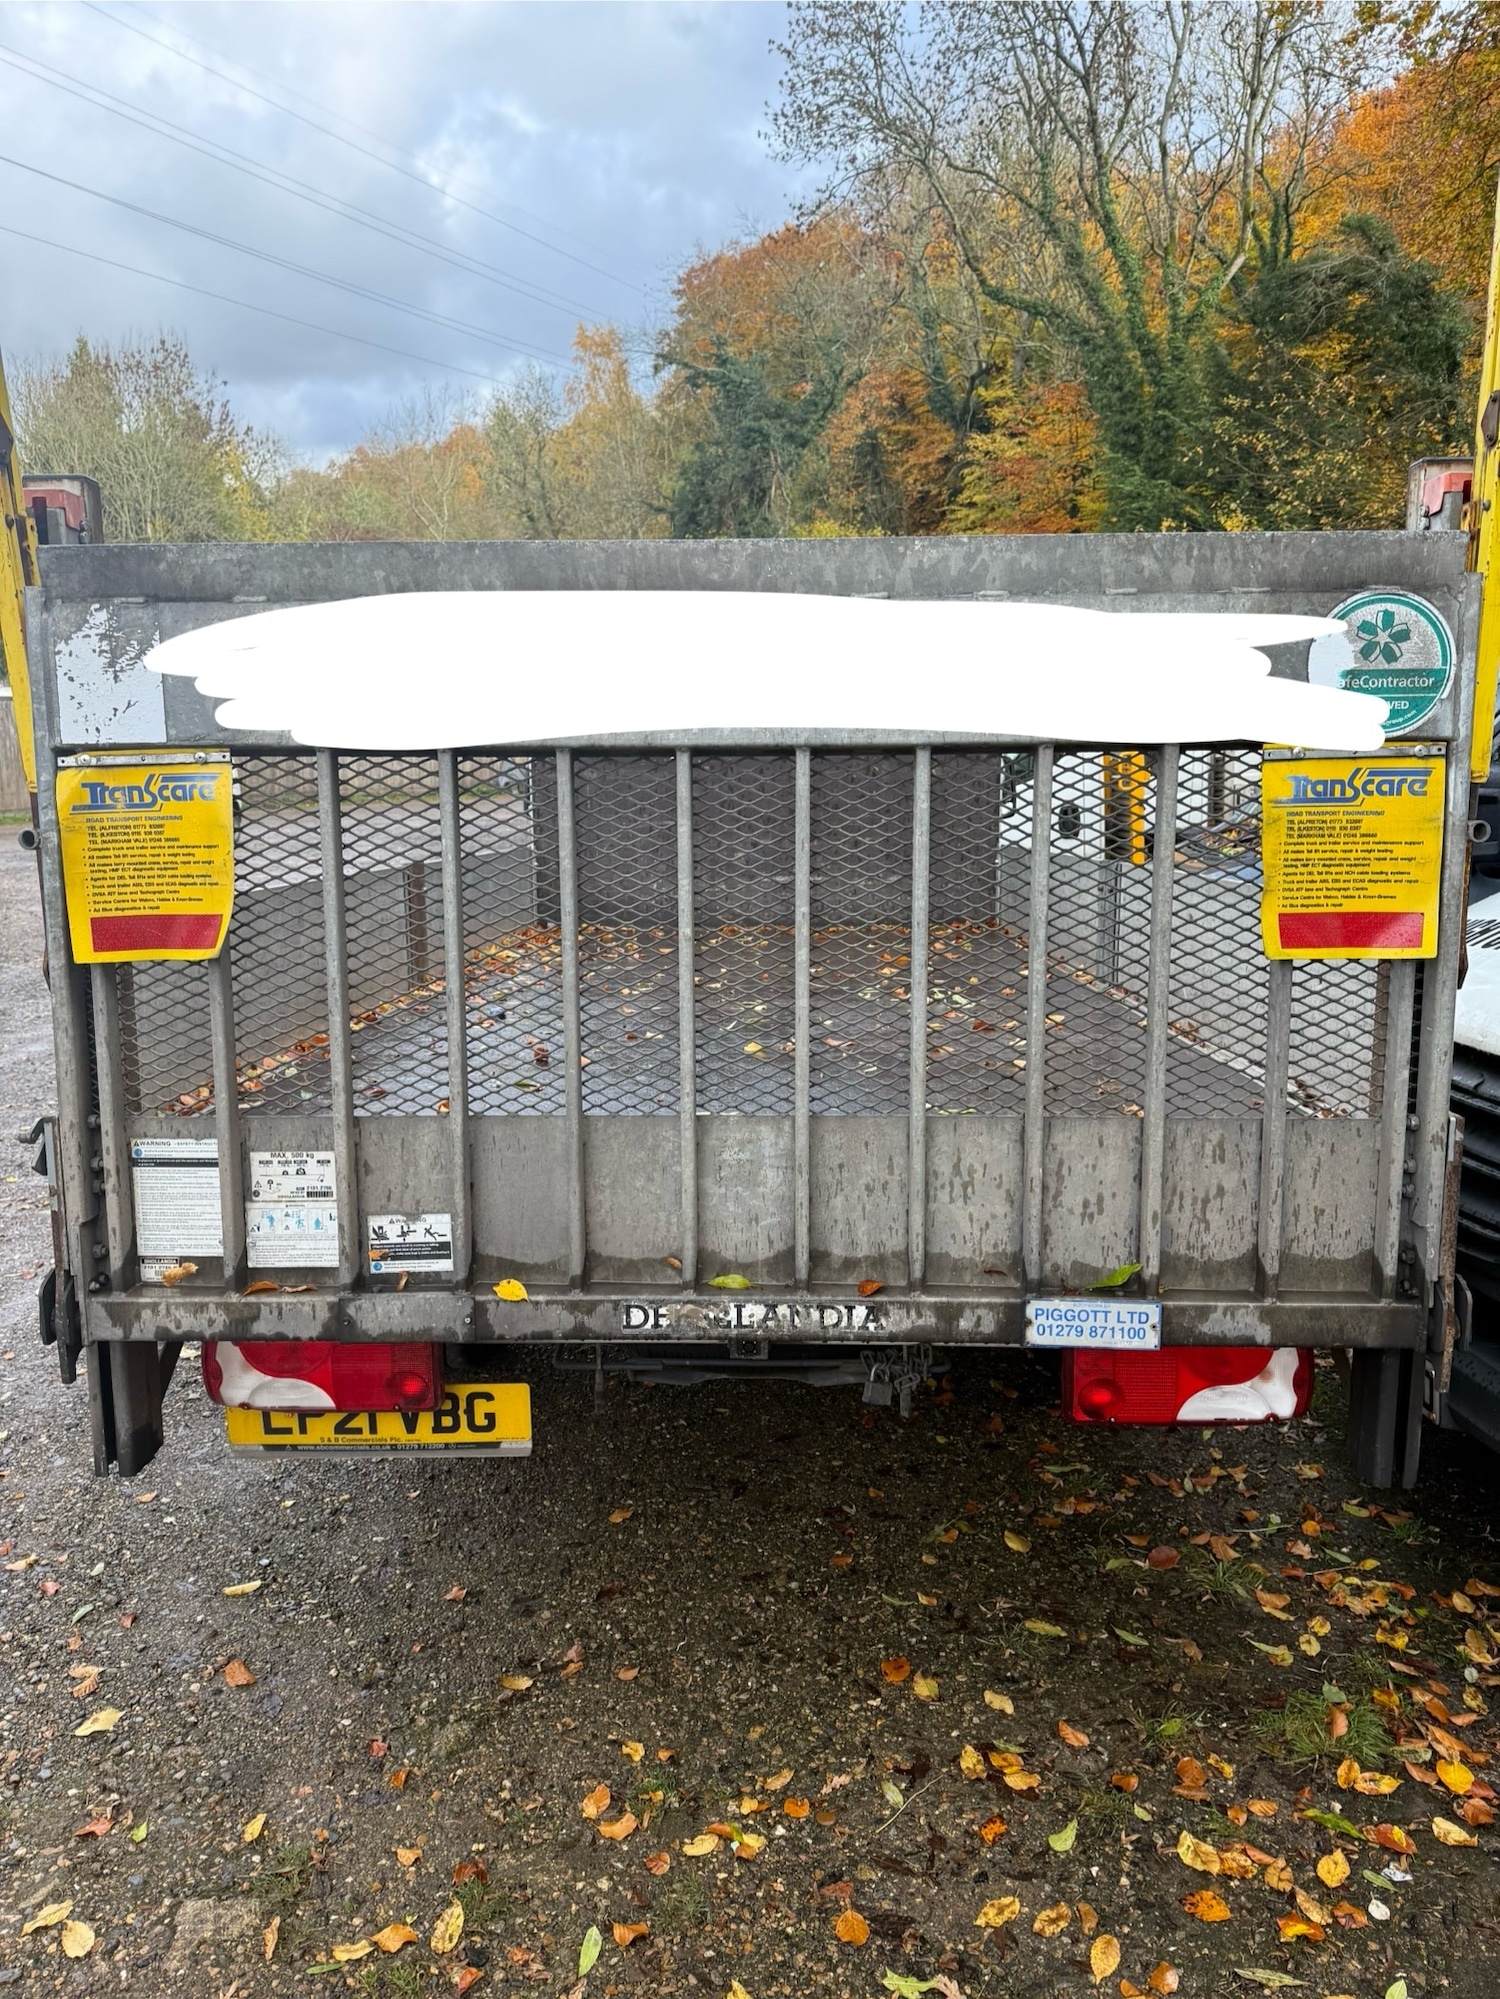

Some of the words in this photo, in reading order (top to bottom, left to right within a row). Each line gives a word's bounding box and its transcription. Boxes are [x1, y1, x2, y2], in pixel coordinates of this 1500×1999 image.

[1336, 675, 1435, 688] afeContractor
[1034, 1308, 1112, 1323] PIGGOTT
[1116, 1311, 1150, 1324] LTD
[1036, 1323, 1084, 1338] 01279
[1088, 1326, 1146, 1340] 871100
